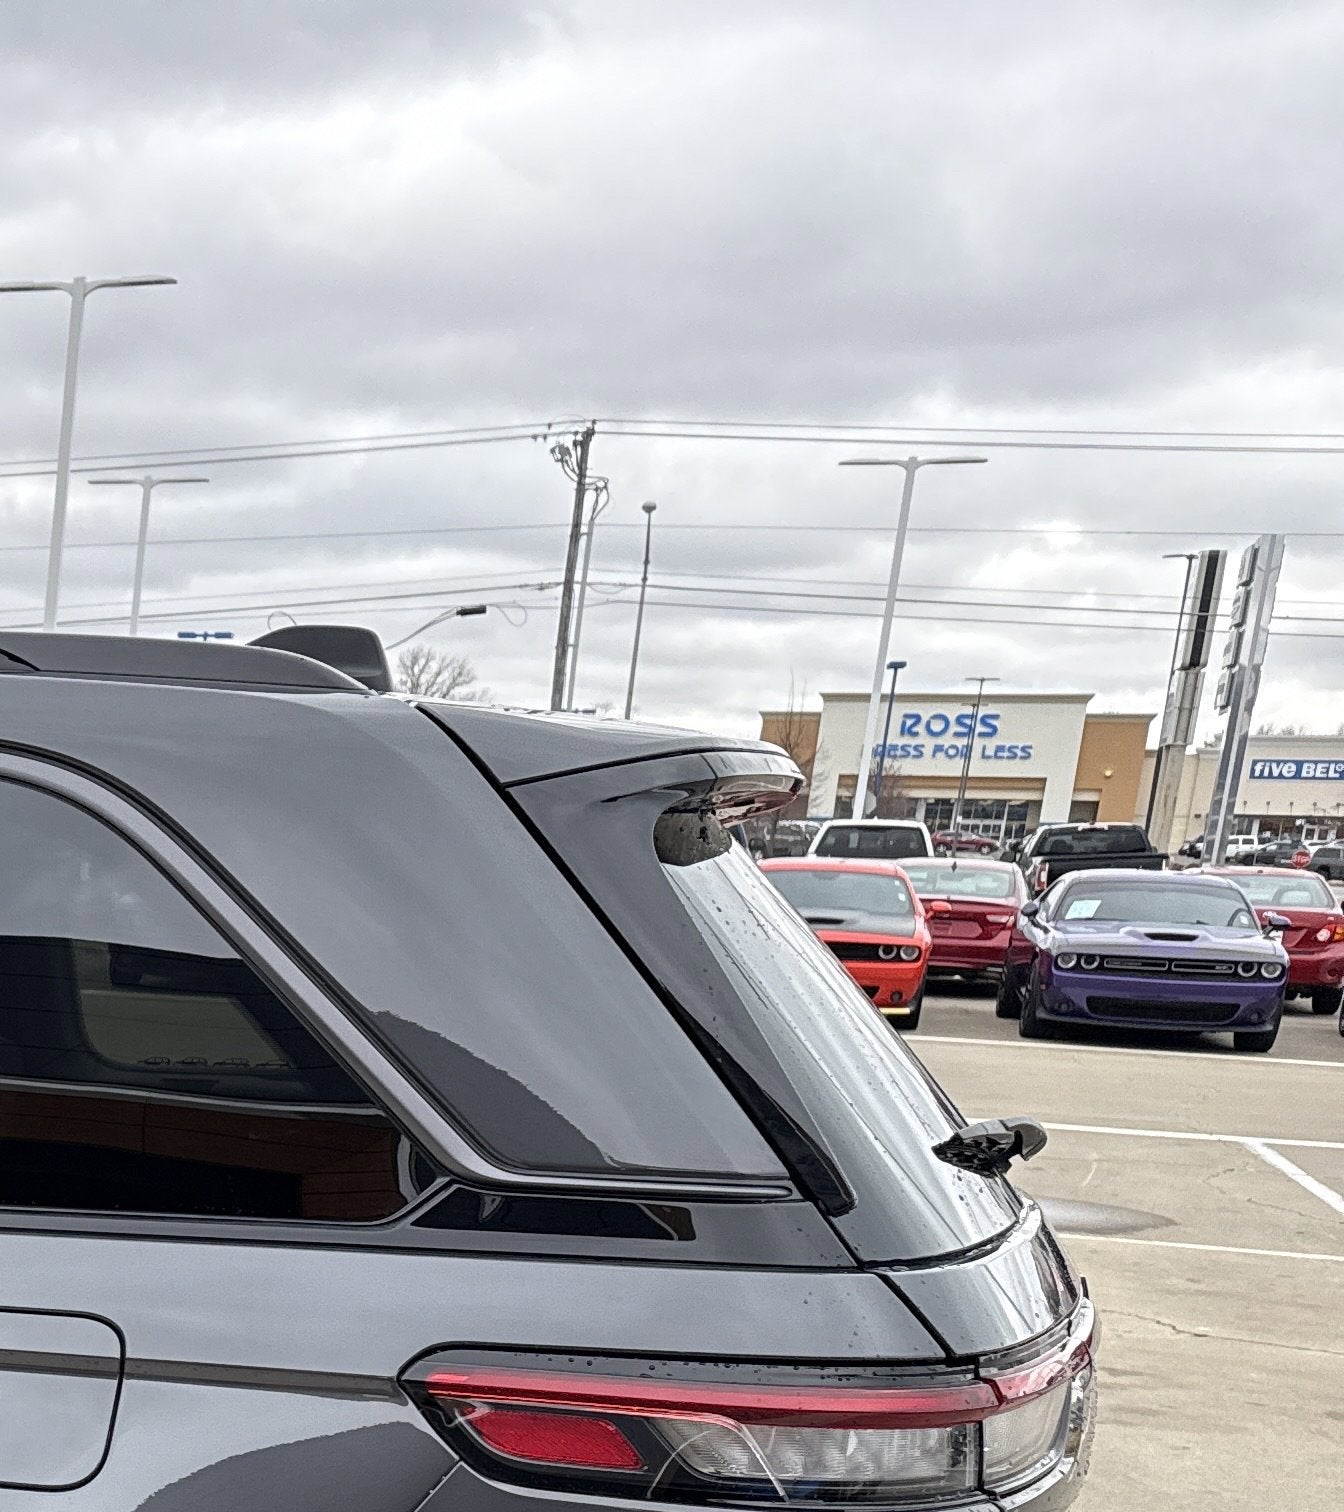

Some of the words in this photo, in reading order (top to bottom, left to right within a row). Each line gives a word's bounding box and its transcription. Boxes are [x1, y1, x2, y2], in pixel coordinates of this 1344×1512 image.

[899, 713, 1001, 738] ROSS
[981, 744, 1033, 760] LESS
[1253, 761, 1296, 778] five
